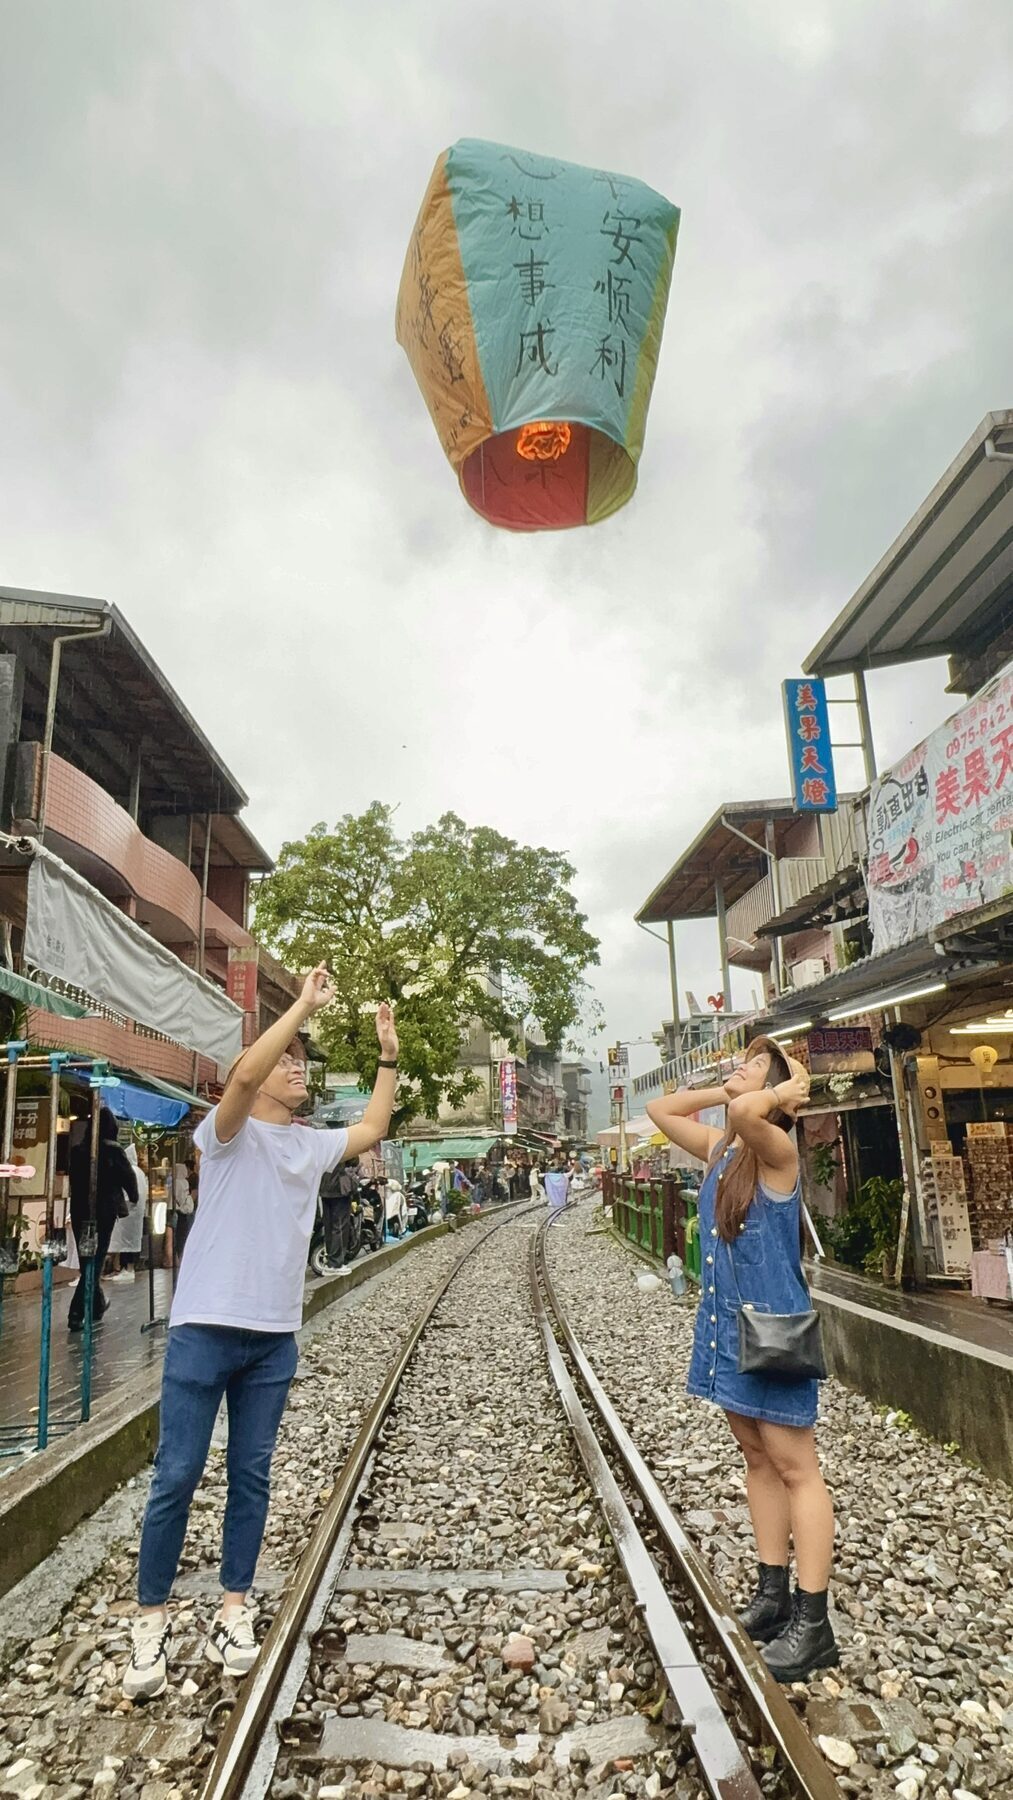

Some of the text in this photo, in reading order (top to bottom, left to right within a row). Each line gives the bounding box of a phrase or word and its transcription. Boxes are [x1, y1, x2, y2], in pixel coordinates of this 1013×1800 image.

[501, 152, 564, 379] 心想事成
[795, 685, 829, 805] 美果天燈
[935, 820, 968, 844] Electric
[937, 850, 951, 864] You
[953, 841, 970, 857] can
[827, 1060, 858, 1073] 101
[16, 1113, 38, 1124] 十分
